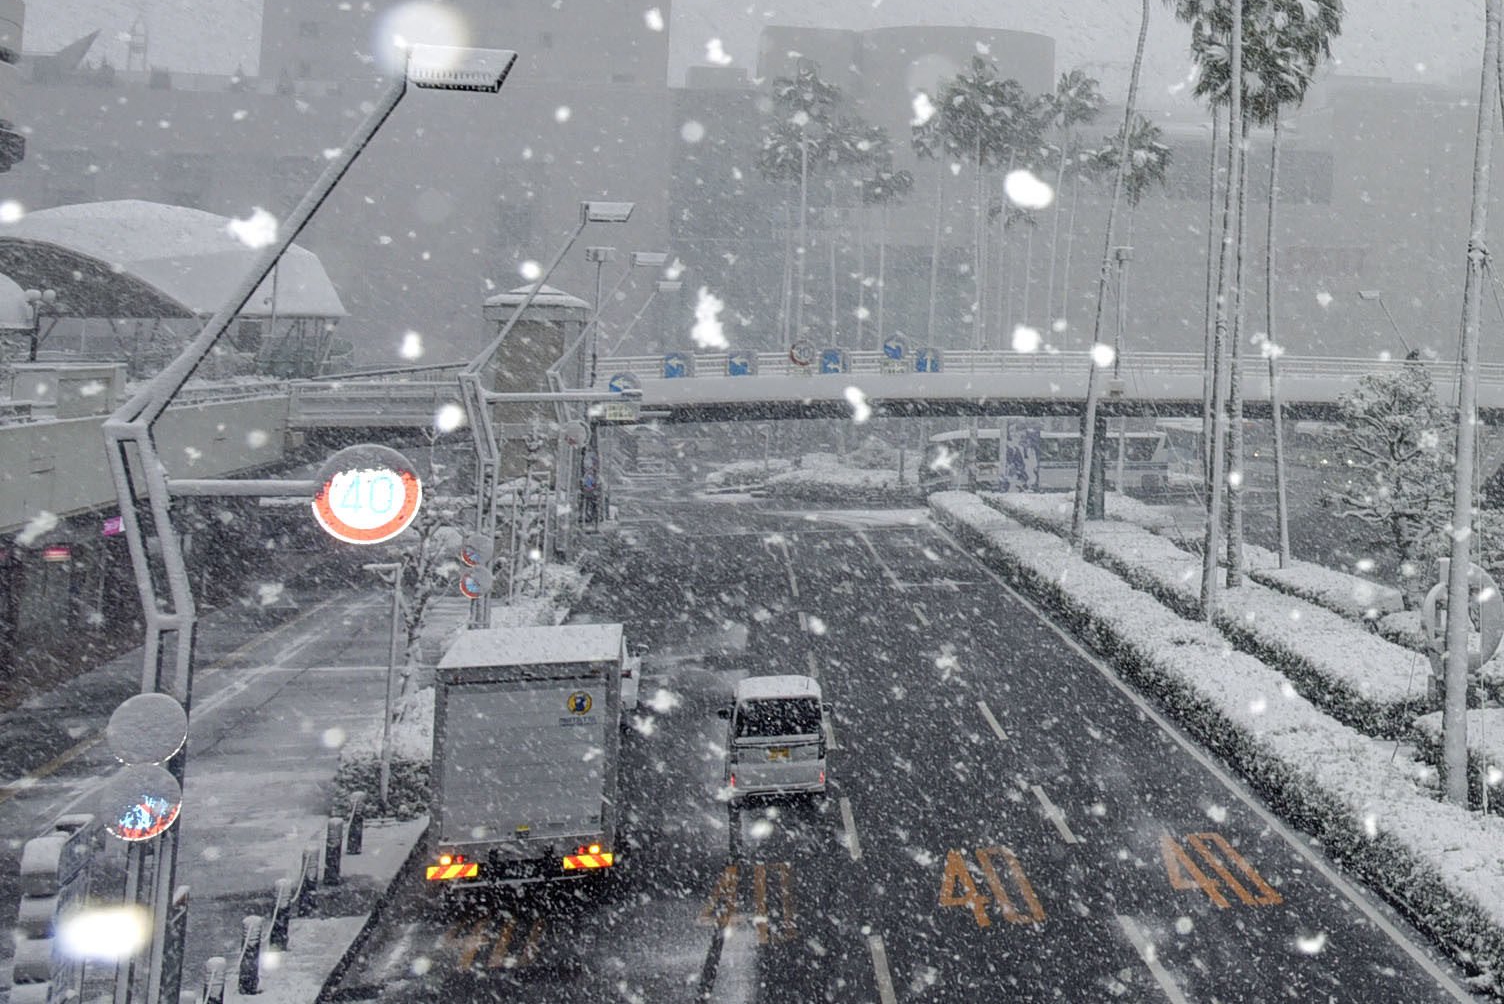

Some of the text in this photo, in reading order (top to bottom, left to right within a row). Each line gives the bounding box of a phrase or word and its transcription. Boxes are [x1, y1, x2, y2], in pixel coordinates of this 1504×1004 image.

[338, 474, 395, 514] 40
[937, 846, 1047, 927] 40
[1161, 832, 1284, 908] 40
